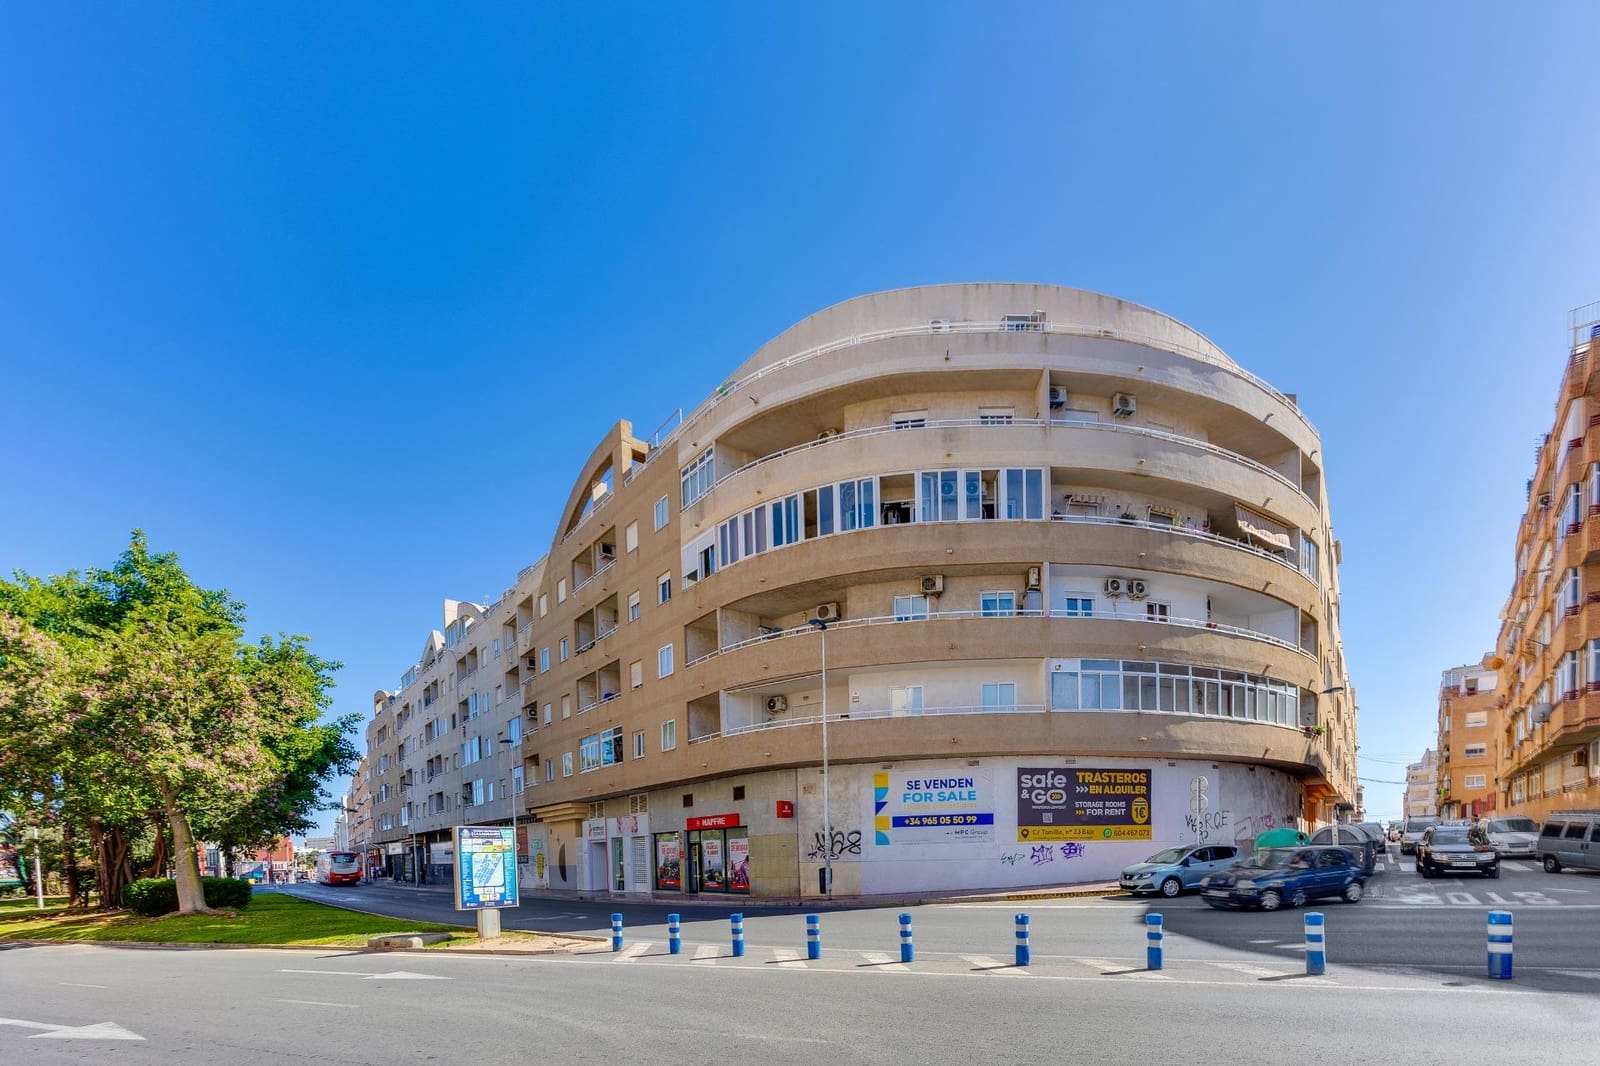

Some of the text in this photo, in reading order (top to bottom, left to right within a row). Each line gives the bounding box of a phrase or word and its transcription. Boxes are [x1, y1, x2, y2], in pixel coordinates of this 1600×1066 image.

[1021, 770, 1067, 788] safe
[1076, 772, 1147, 783] TRASTEROS
[906, 778, 974, 790] SE VENDEN
[1089, 785, 1147, 795] EN ALQUILER
[903, 791, 977, 803] FOR SALE
[1031, 789, 1067, 804] GO
[702, 817, 726, 826] MAPFRE
[904, 815, 977, 826] +34 965 05 50 99
